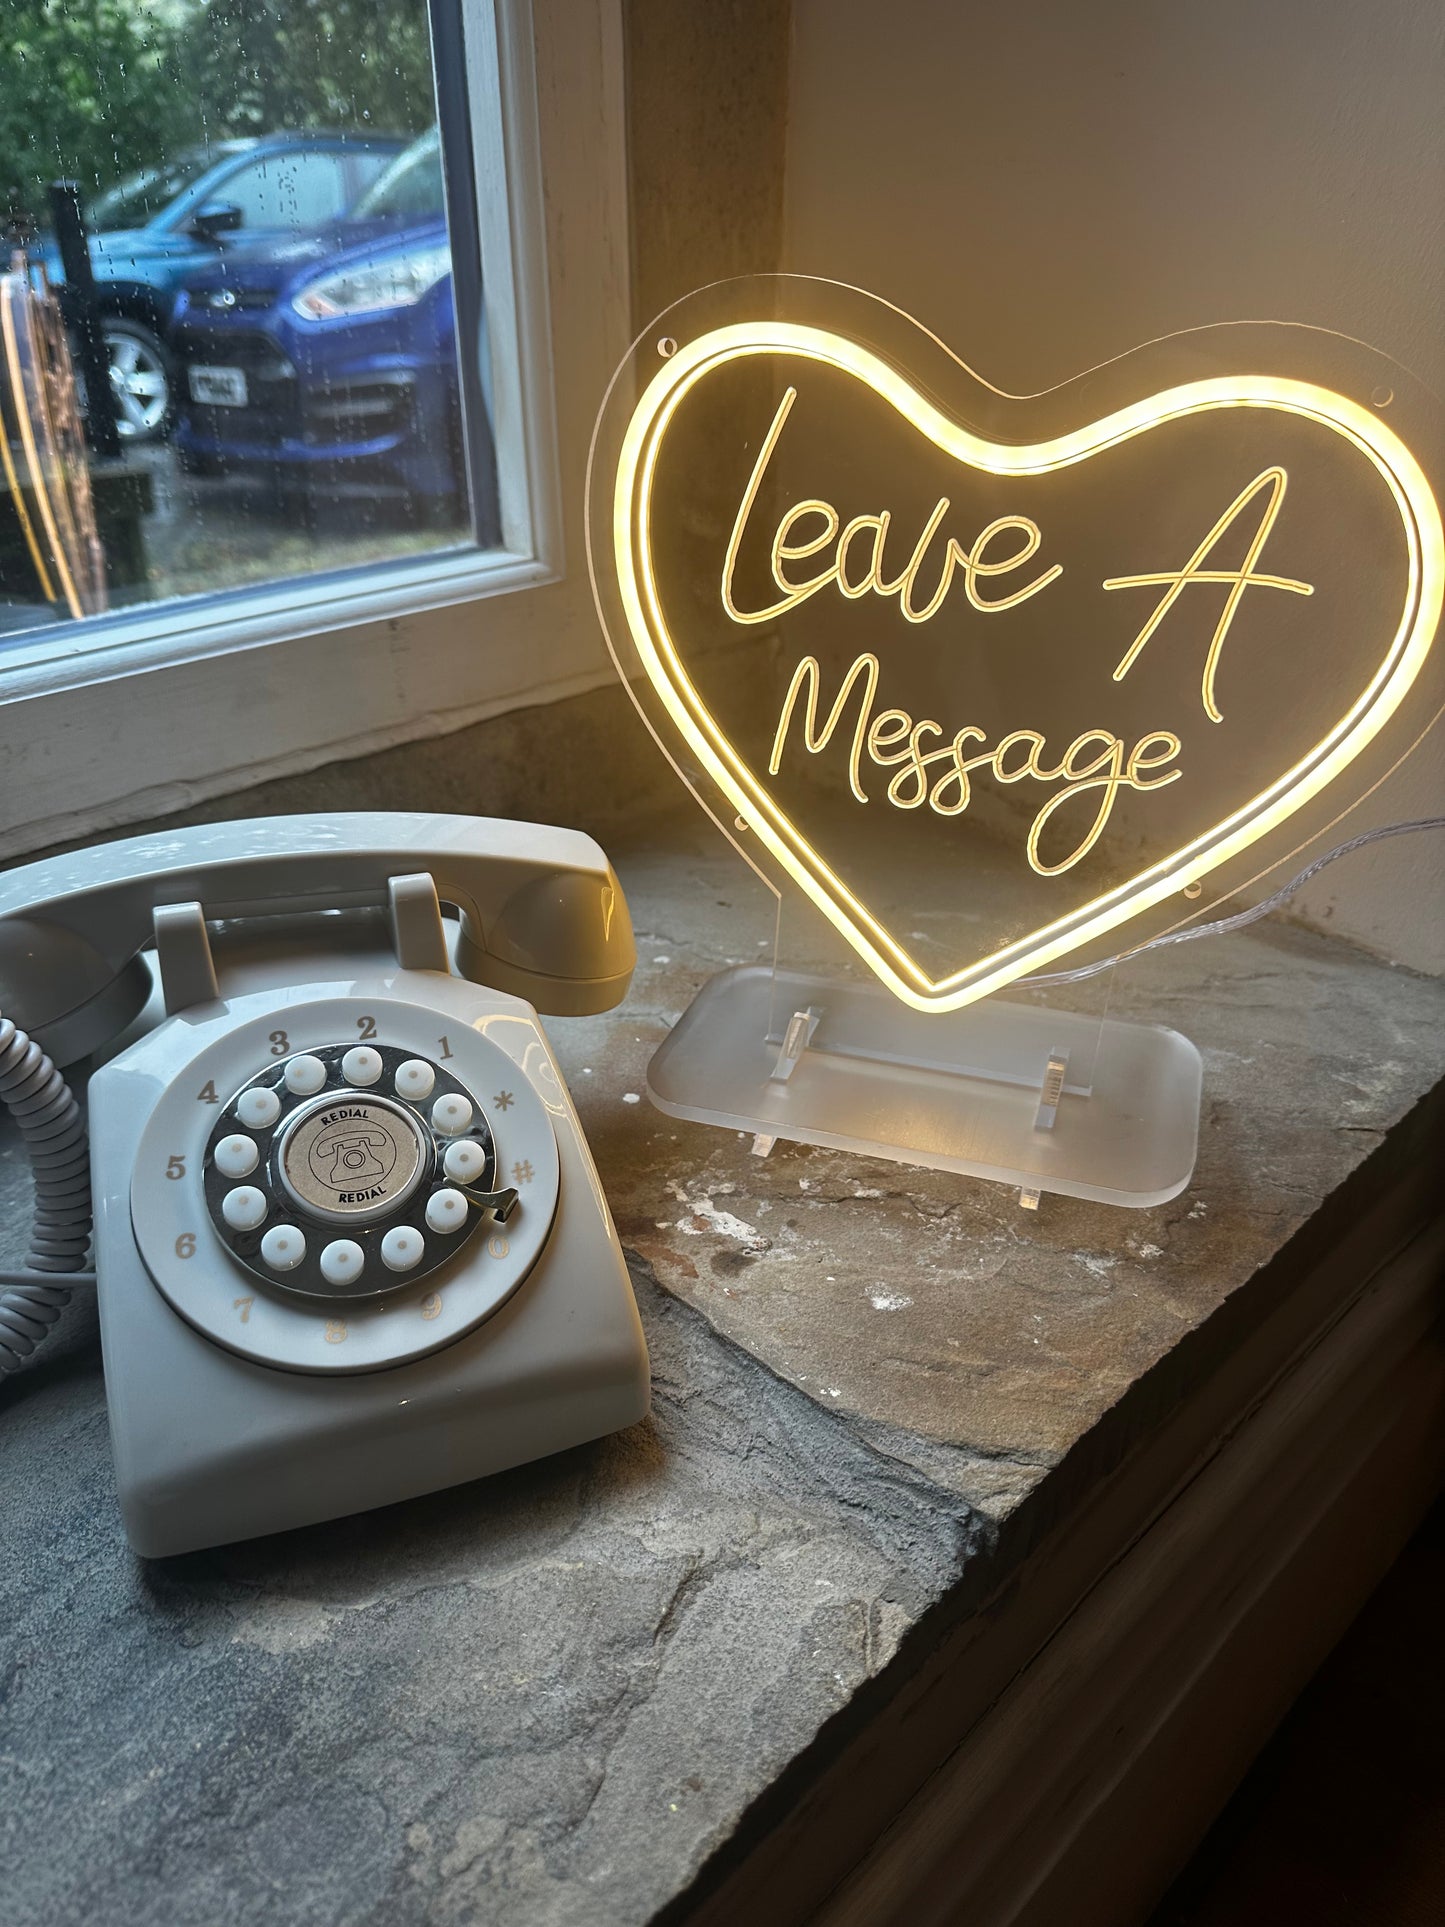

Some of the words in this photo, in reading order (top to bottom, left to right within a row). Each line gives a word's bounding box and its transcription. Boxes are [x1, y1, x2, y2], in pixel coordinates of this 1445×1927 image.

[721, 387, 1063, 624] Leave
[1103, 466, 1314, 723] A
[769, 653, 1182, 876] Message
[357, 1015, 377, 1040] 2
[269, 1030, 290, 1056] 3
[438, 1036, 454, 1060] 1
[198, 1079, 219, 1104] 4
[321, 1108, 370, 1126] REDIAL
[166, 1155, 186, 1180] 5
[511, 1160, 535, 1184] #
[339, 1186, 387, 1204] REDIAL
[175, 1232, 196, 1258] 6
[234, 1297, 254, 1323] 7
[421, 1293, 443, 1321] 9
[324, 1318, 348, 1344] 8
